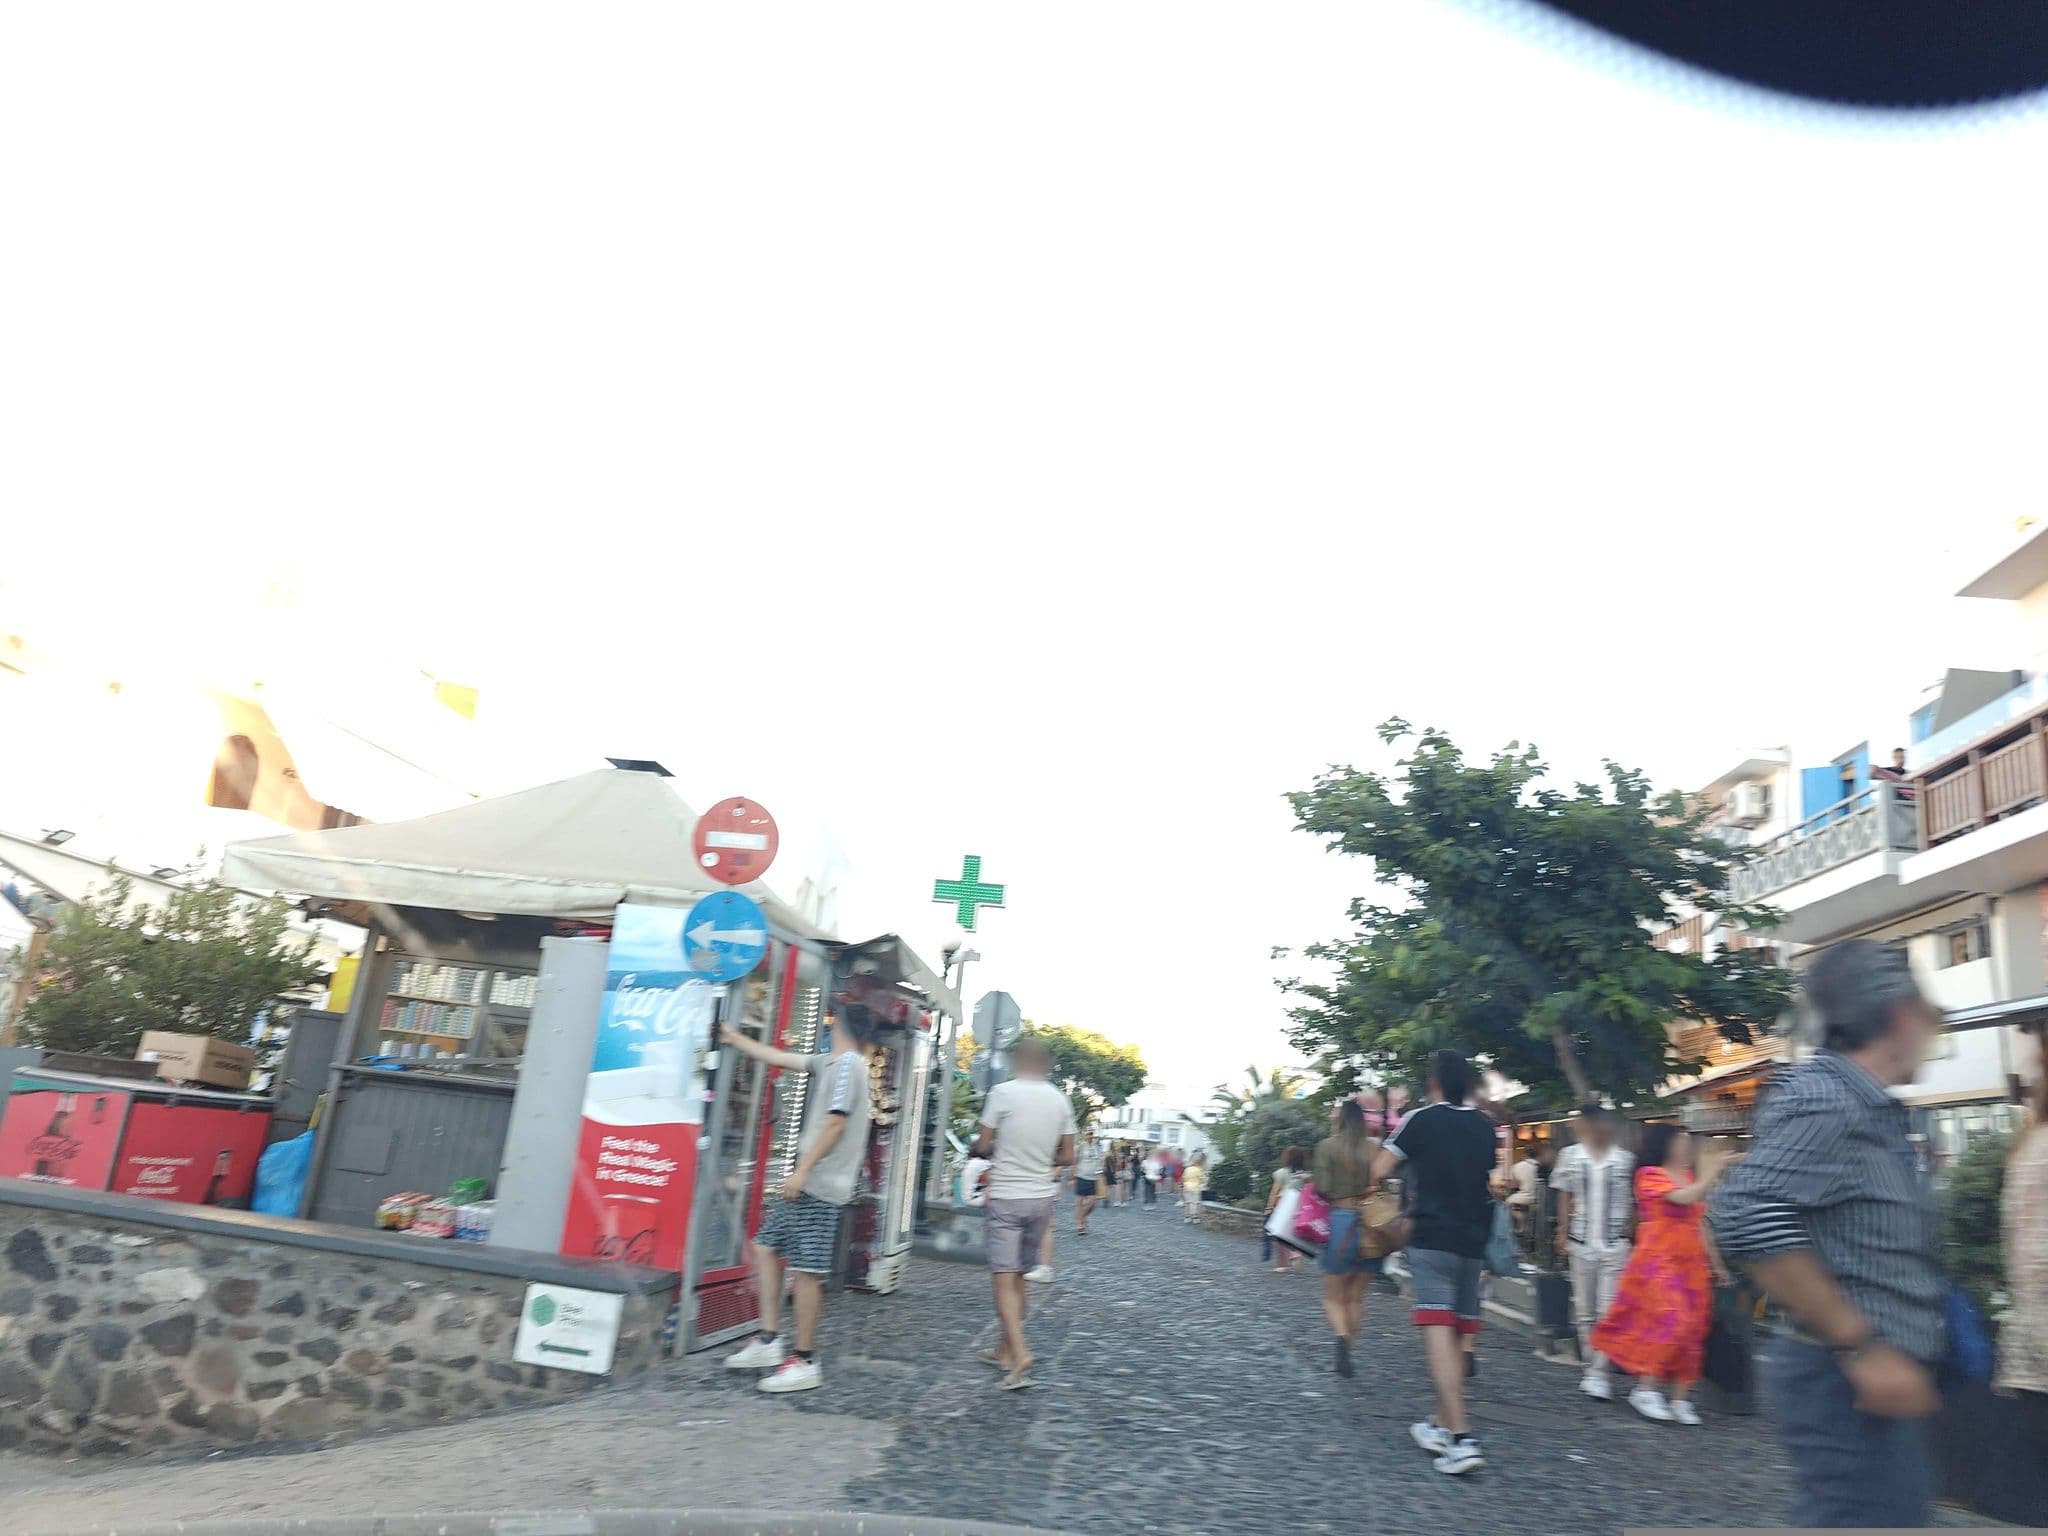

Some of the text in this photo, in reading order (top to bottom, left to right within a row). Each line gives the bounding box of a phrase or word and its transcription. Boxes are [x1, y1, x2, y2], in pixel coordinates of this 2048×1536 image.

[601, 1136, 660, 1153] Feel the
[633, 1155, 678, 1172] Magic
[595, 1166, 612, 1179] in
